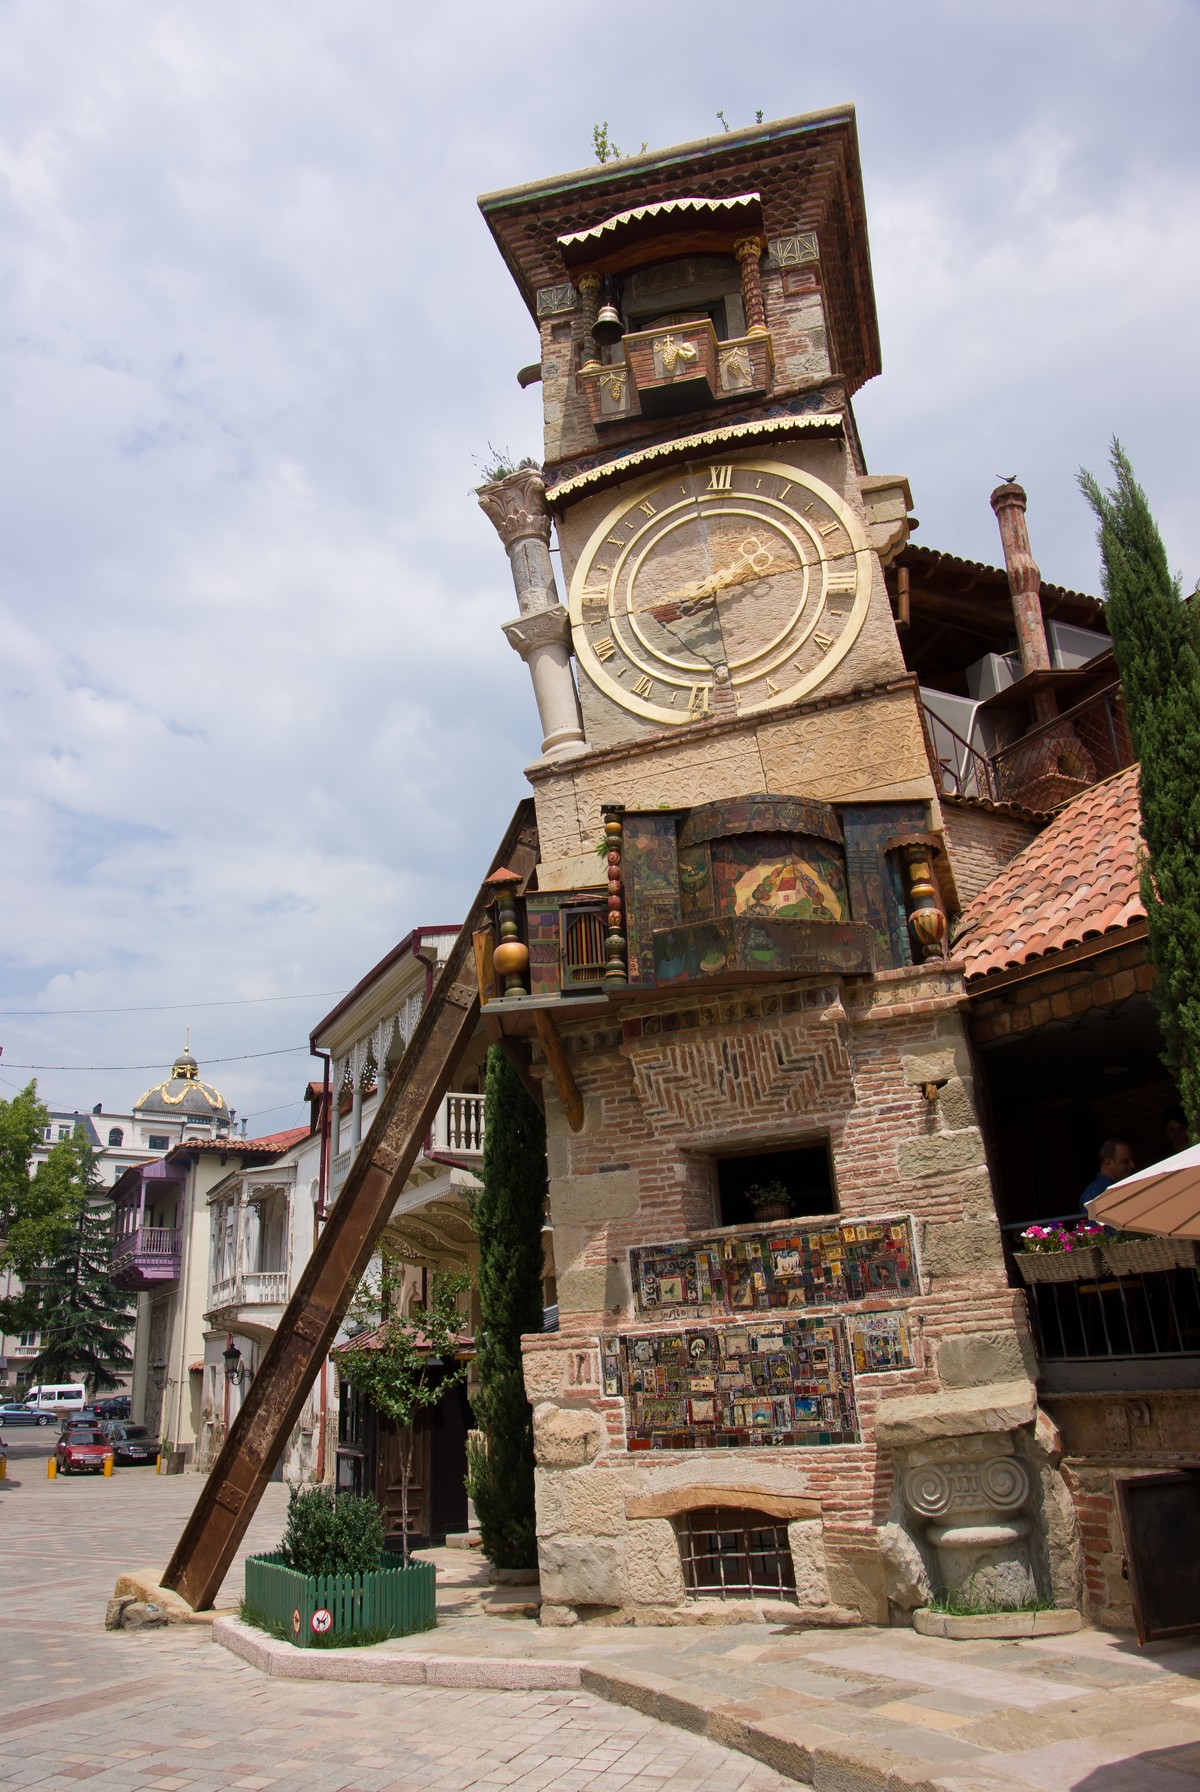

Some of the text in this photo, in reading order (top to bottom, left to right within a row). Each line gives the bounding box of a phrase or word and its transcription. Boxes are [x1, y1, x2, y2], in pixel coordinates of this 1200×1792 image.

[706, 465, 733, 489] XII
[779, 484, 792, 499] I
[638, 500, 658, 519] XI
[819, 522, 840, 536] II
[607, 534, 625, 549] X
[827, 571, 857, 589] III
[582, 584, 608, 600] IX
[593, 636, 615, 662] VIII
[813, 632, 833, 651] IV
[631, 676, 654, 698] VII
